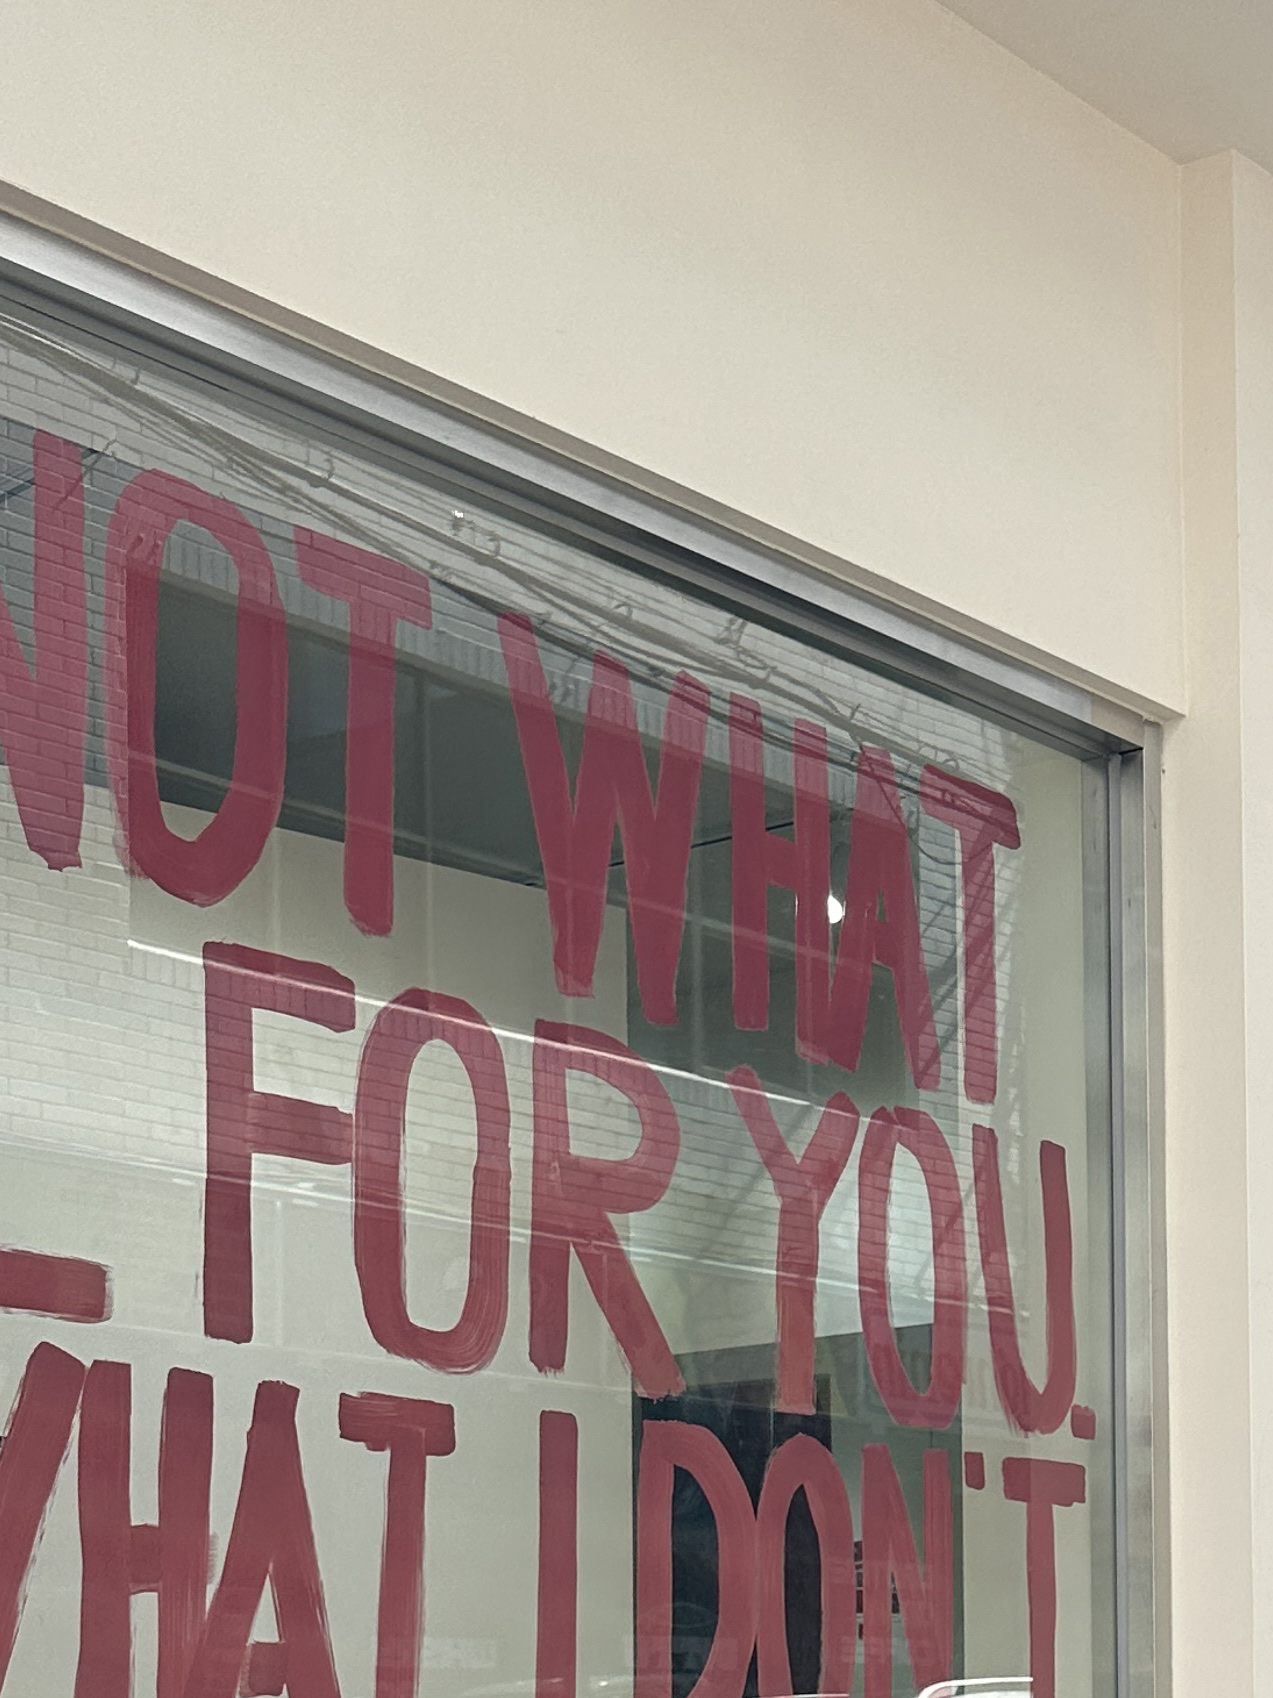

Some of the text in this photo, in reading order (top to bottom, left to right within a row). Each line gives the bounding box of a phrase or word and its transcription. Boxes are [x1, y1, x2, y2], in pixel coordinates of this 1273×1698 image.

[498, 611, 1021, 1104] WHAT
[203, 941, 1097, 1440] FOR YOU.
